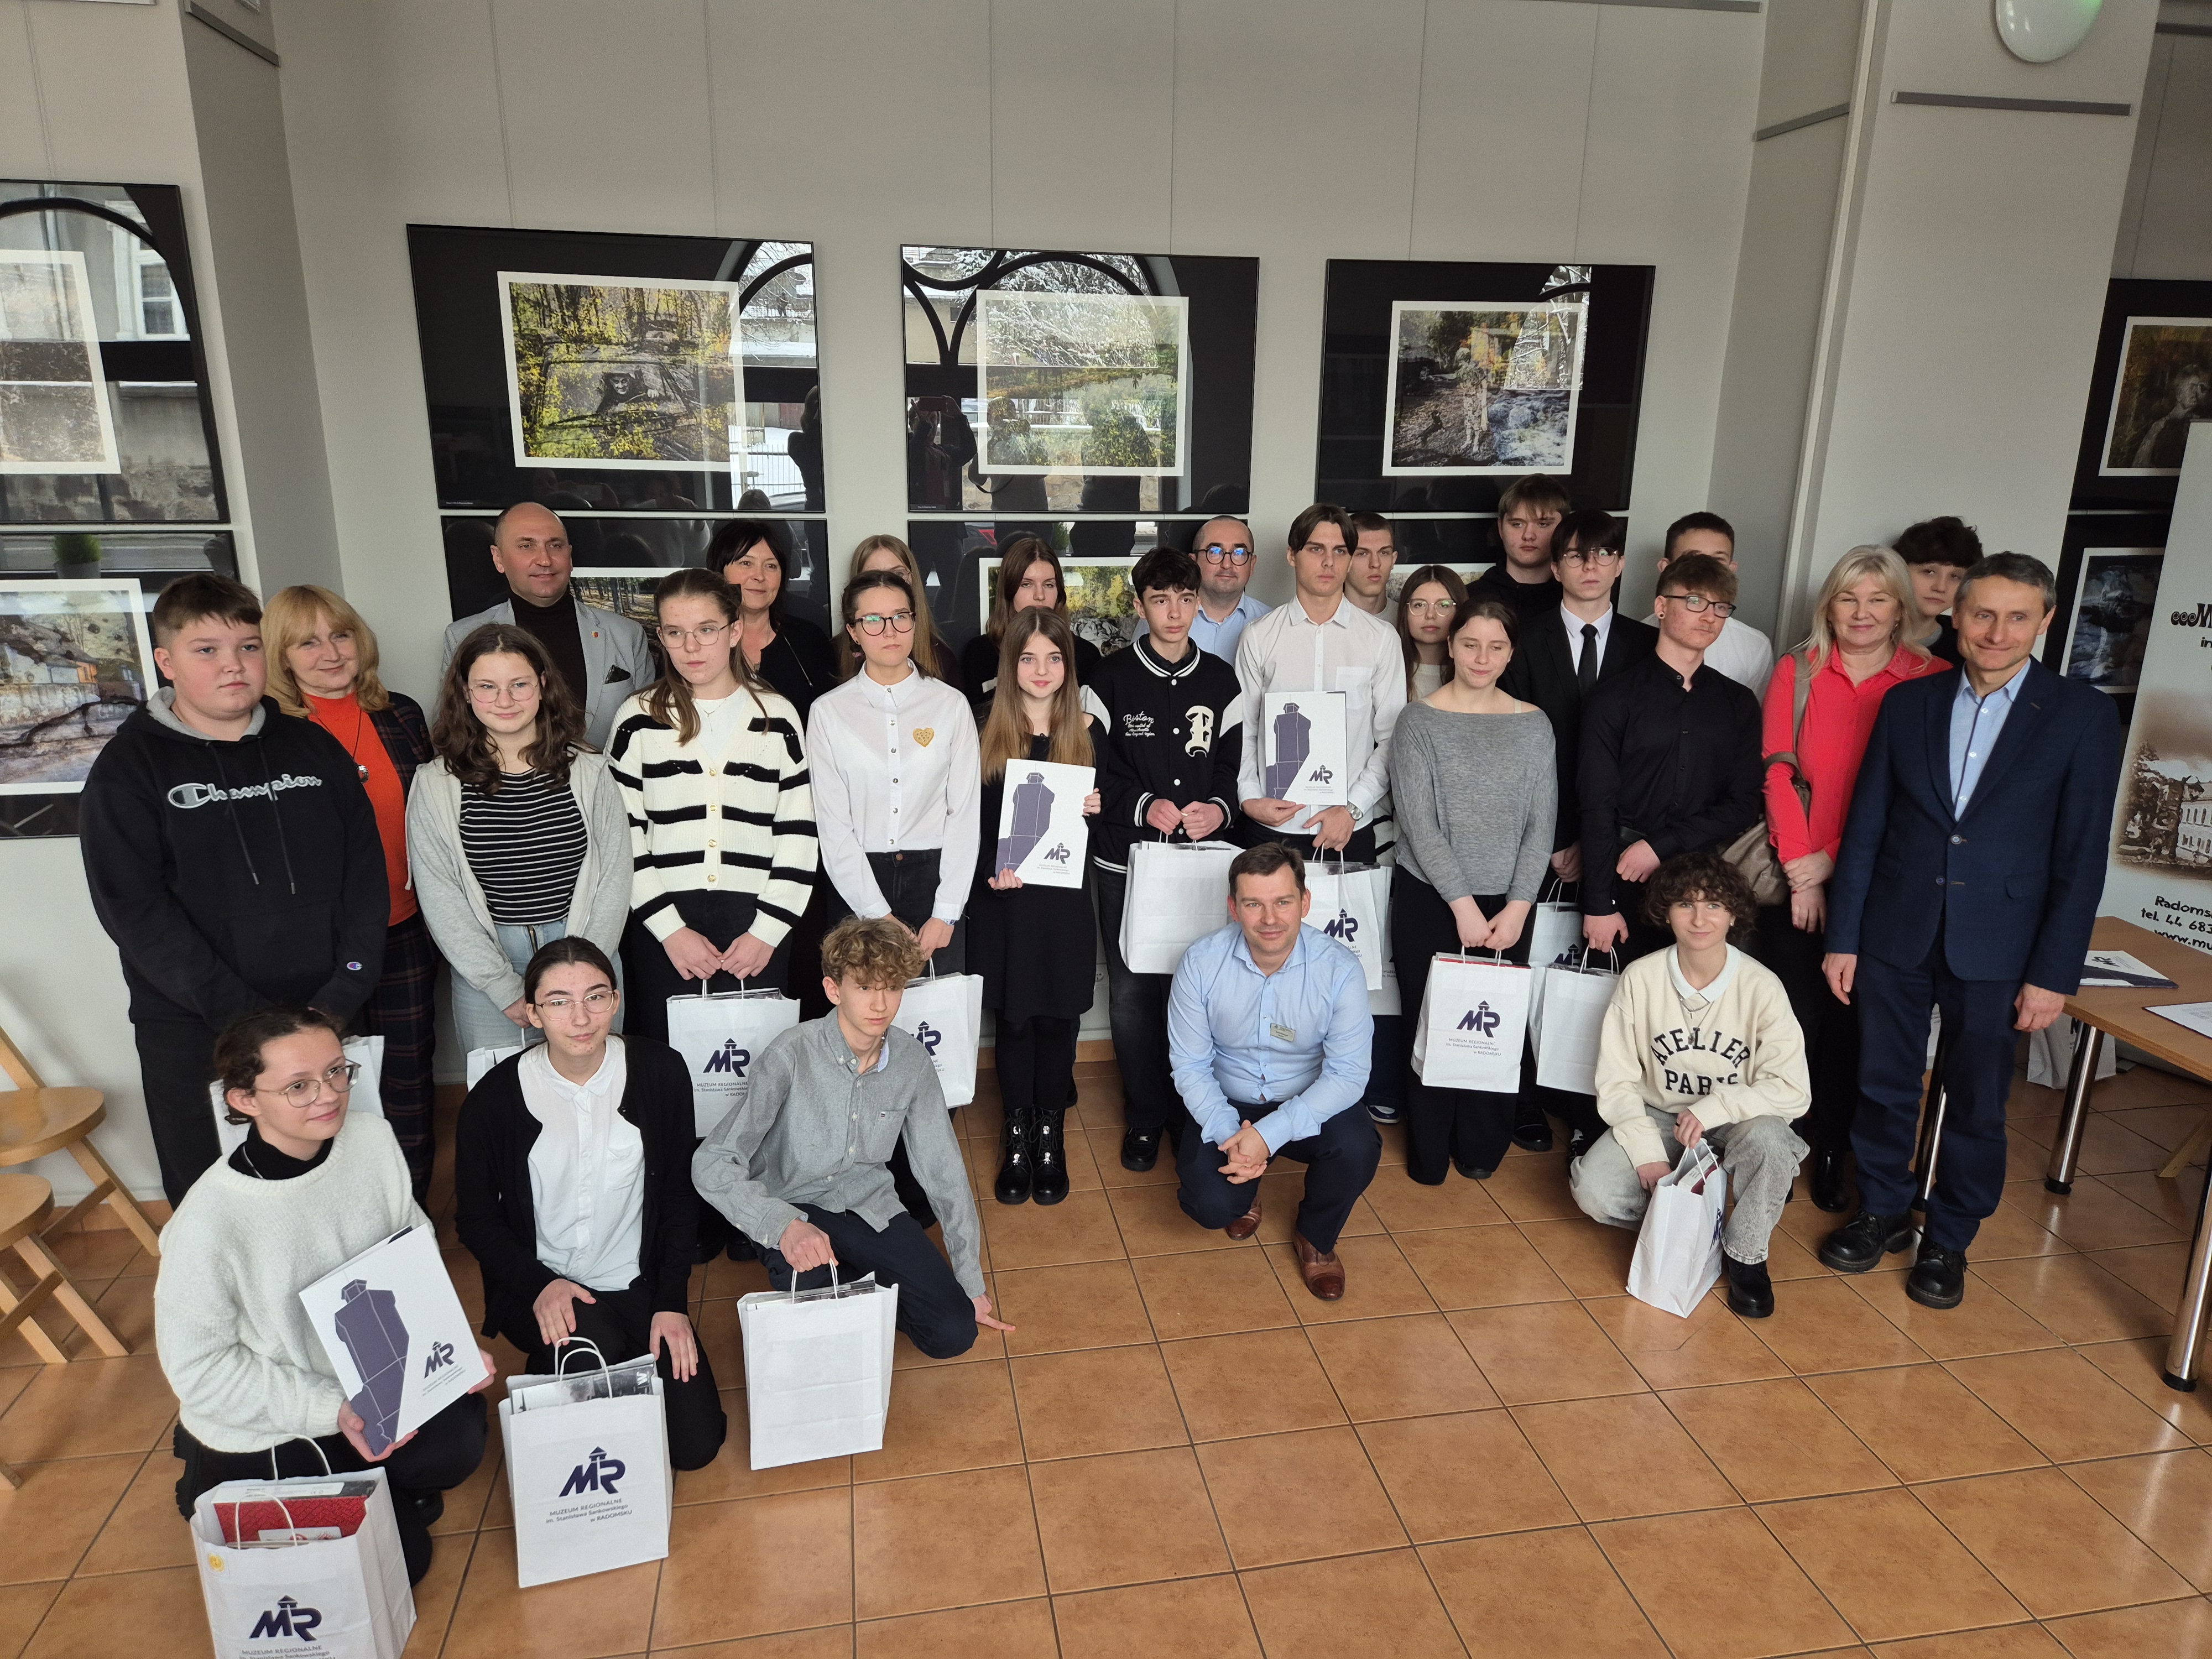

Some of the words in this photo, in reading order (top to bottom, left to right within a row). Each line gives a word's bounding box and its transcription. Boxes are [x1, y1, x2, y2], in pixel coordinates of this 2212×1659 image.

[168, 774, 322, 808] Champion
[2141, 907, 2159, 922] tel.
[2166, 914, 2183, 927] 44
[2155, 895, 2212, 919] Radoms
[1651, 1027, 1751, 1069] ATELIER
[1665, 1068, 1739, 1095] PARS
[550, 1506, 579, 1516] MUZEUM
[581, 1498, 623, 1511] REGIONALNE
[588, 1504, 629, 1516] Sankowskiego
[597, 1509, 633, 1521] RADOMSKU
[275, 1645, 322, 1653] REGIONALNE
